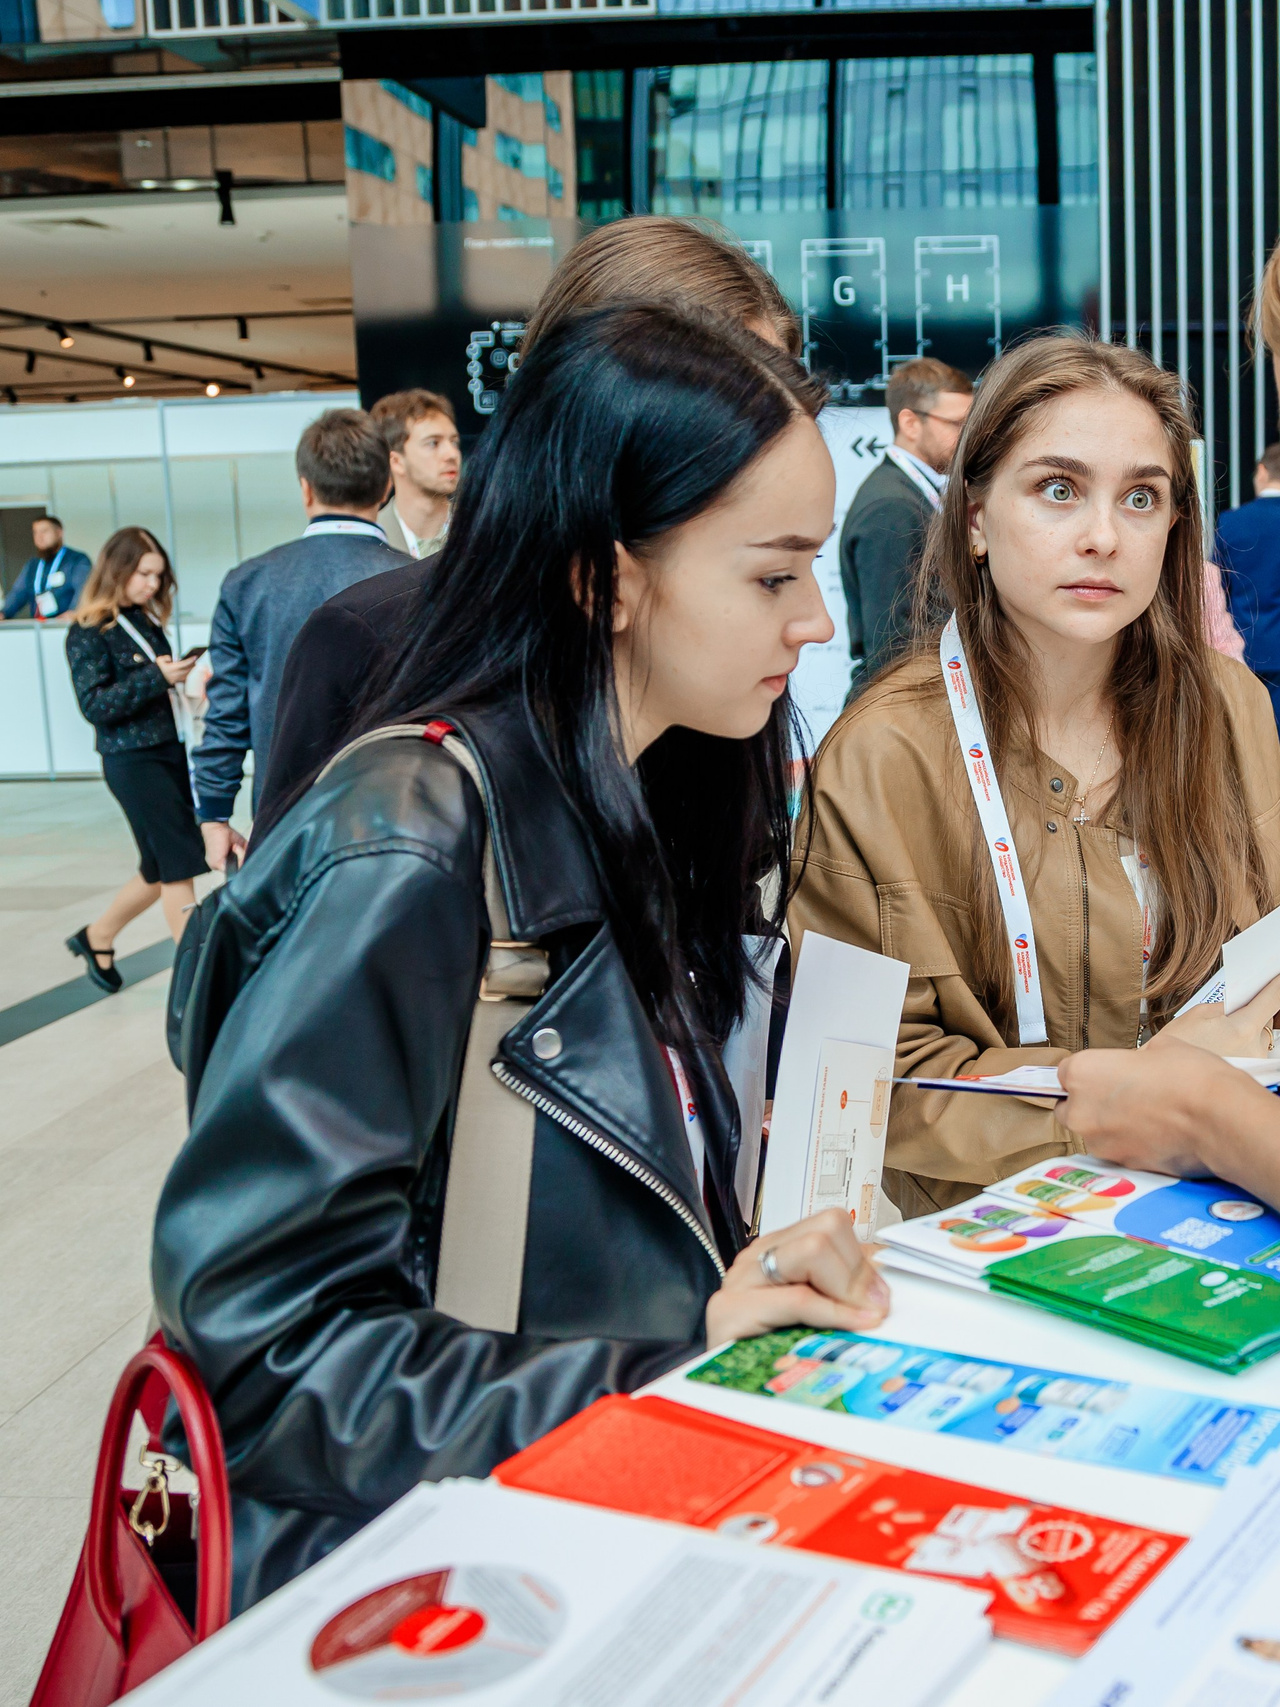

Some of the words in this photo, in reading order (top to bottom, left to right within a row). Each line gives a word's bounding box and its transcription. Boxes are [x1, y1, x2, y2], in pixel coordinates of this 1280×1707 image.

[833, 275, 856, 307] G
[946, 273, 969, 303] H
[998, 855, 1007, 878] ОБЩЕСТВО
[1007, 854, 1015, 881] РОССИЙСКОЕ
